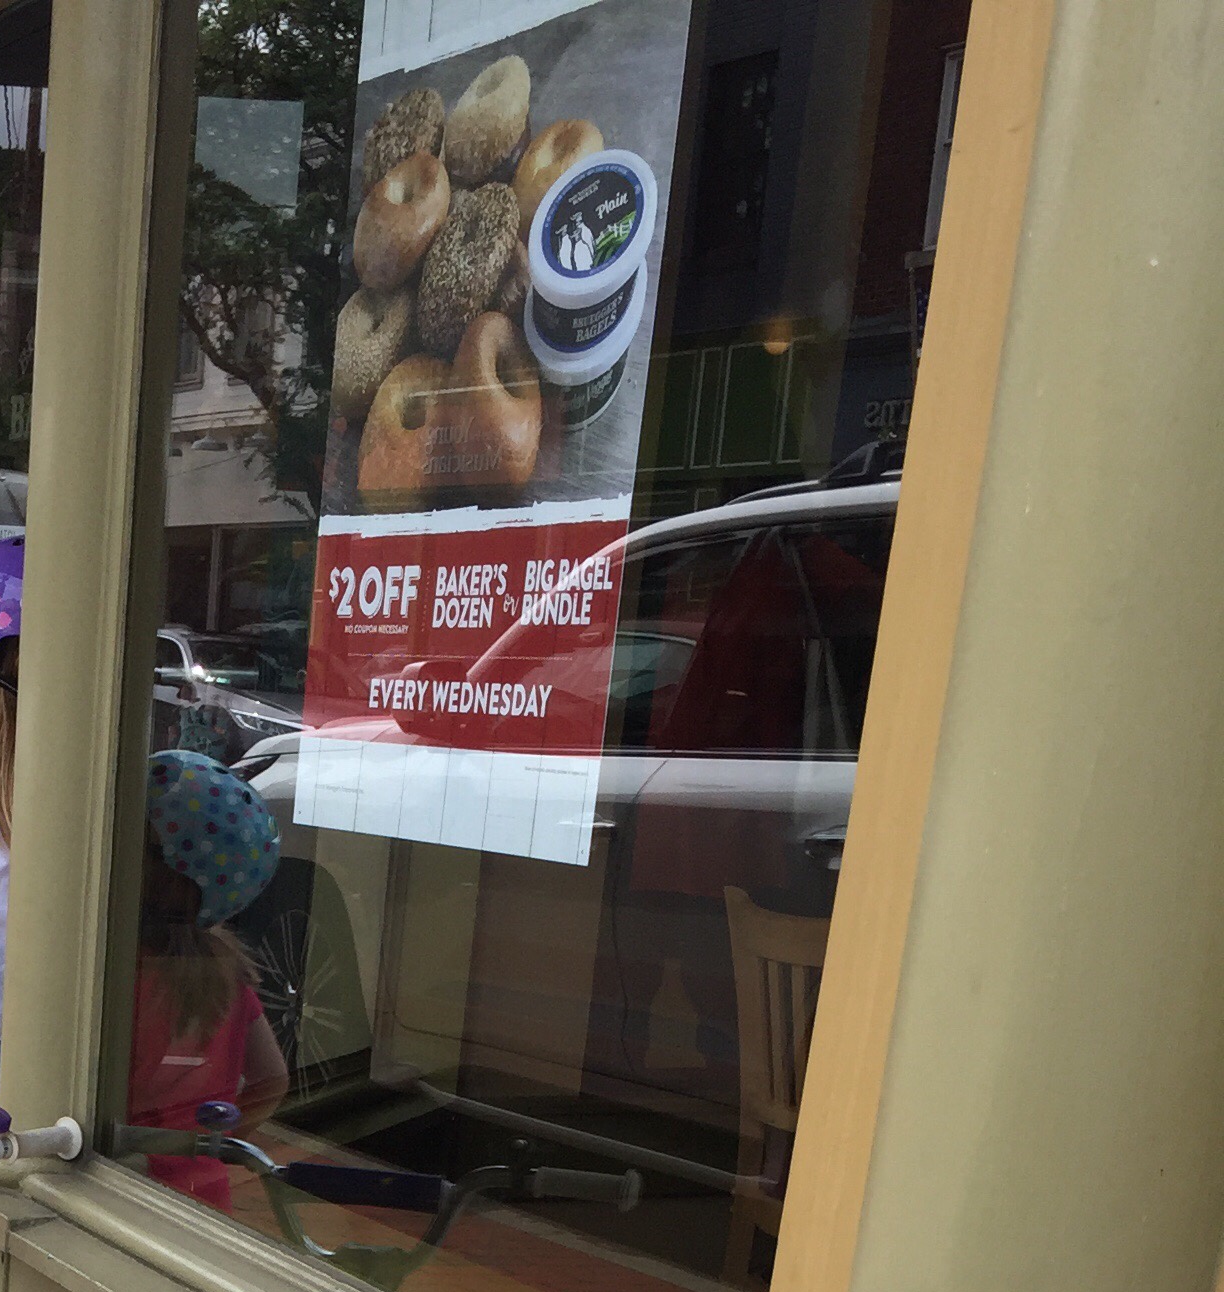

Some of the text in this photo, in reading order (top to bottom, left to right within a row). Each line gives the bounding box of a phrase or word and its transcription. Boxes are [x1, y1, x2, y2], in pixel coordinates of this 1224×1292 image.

[596, 191, 629, 220] Plain
[576, 309, 617, 342] BAGELS
[435, 563, 509, 597] BAKER'S
[524, 556, 614, 592] BIG BAGEL
[358, 564, 422, 619] OFF
[432, 593, 520, 628] DOZEN or
[520, 592, 593, 626] BUNDLE
[344, 624, 409, 635] NO COUPON NECESSARY
[368, 678, 553, 718] EVERY WEDNESDAY
